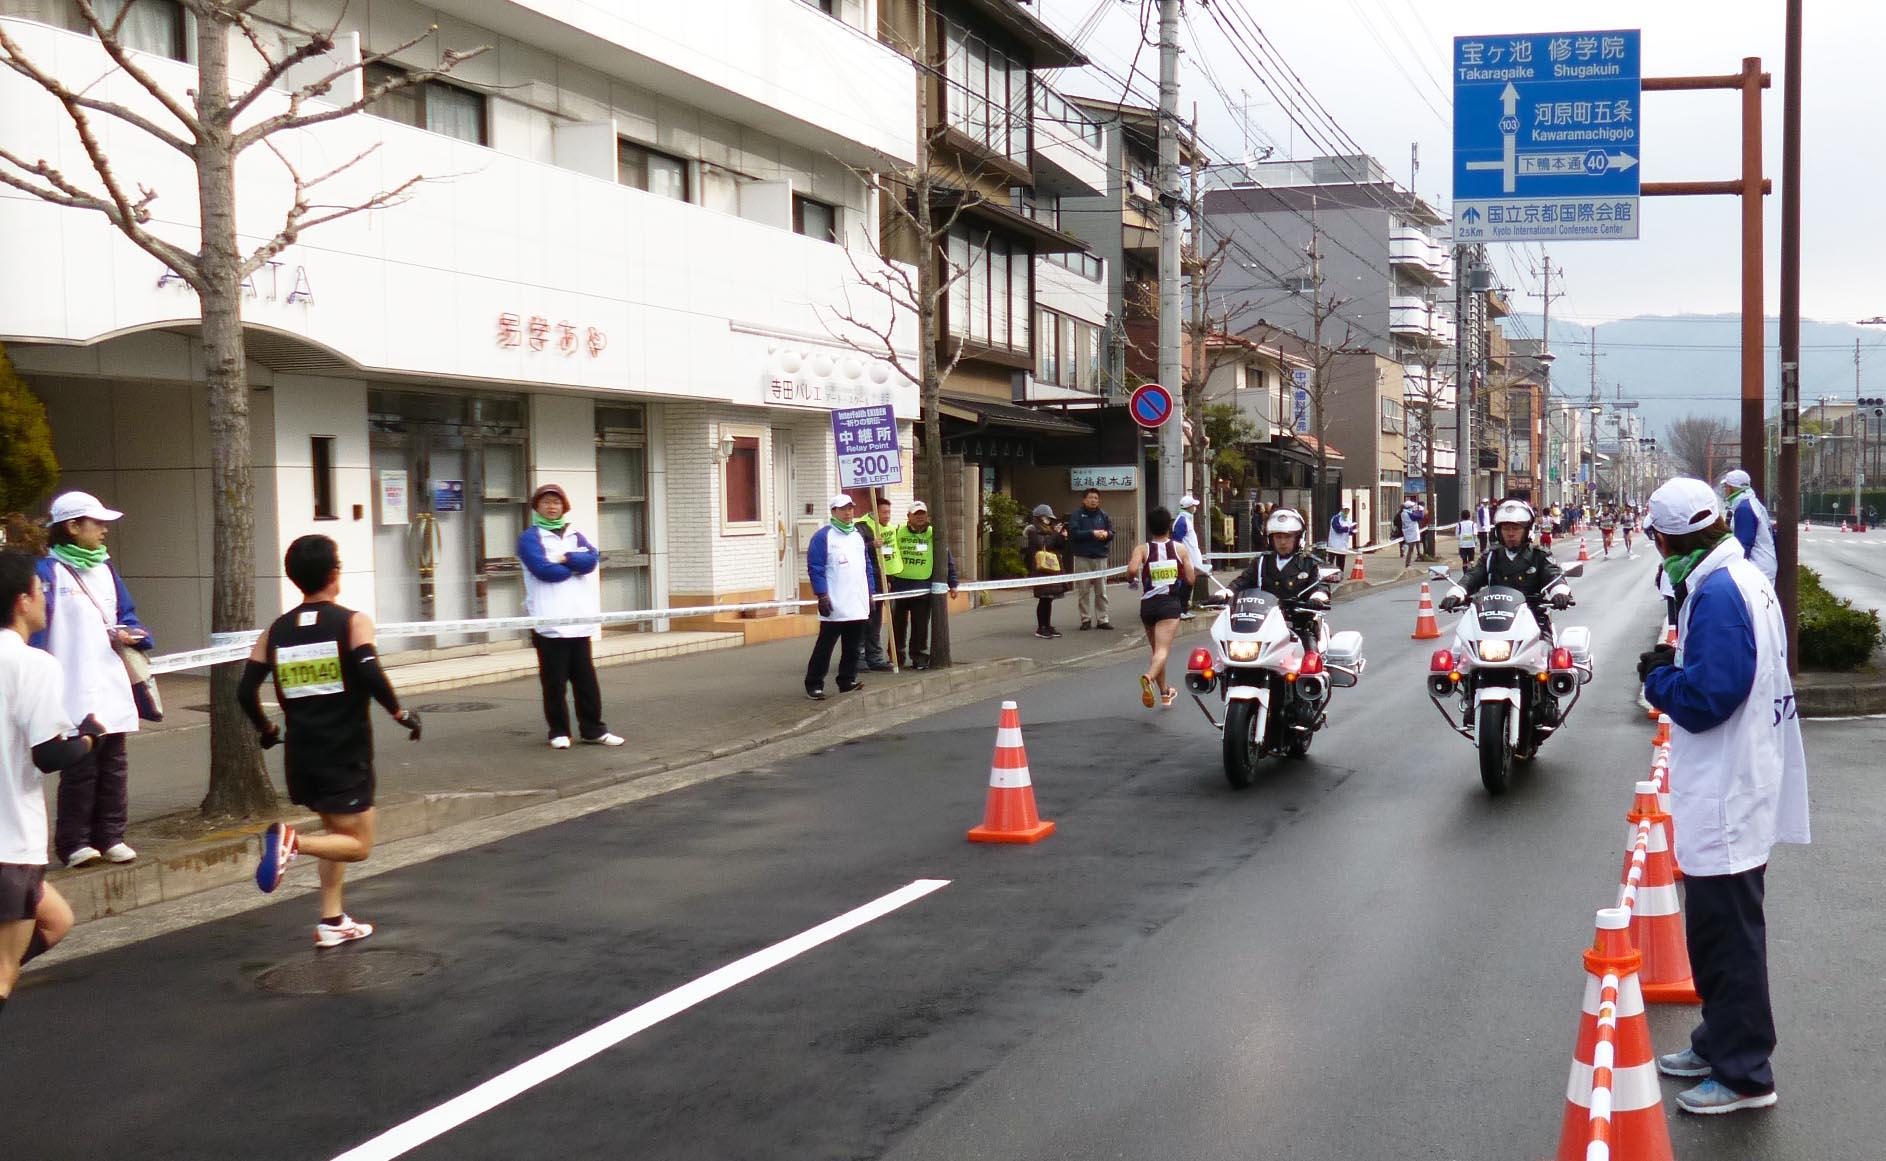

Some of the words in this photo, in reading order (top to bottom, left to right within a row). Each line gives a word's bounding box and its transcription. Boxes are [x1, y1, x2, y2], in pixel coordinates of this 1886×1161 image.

[1549, 36, 1624, 60] 修学院
[1459, 67, 1534, 80] Takaragaike
[1554, 64, 1619, 77] Shugakuin
[1534, 100, 1633, 126] 河原町五条
[1502, 119, 1517, 130] 103
[1532, 127, 1634, 142] Kawaramachigojo
[1522, 157, 1581, 171] 下鴨本通
[1587, 156, 1605, 170] 40
[1488, 203, 1632, 223] 国立京都国際会館
[1493, 225, 1512, 236] Kyoto
[1514, 224, 1557, 235] International
[1560, 224, 1598, 235] Conference
[1601, 223, 1623, 234] Center
[839, 427, 892, 445] 中継所
[846, 444, 868, 452] Relay
[869, 442, 889, 450] Point
[852, 455, 889, 476] 300
[1479, 610, 1514, 618] POLICE
